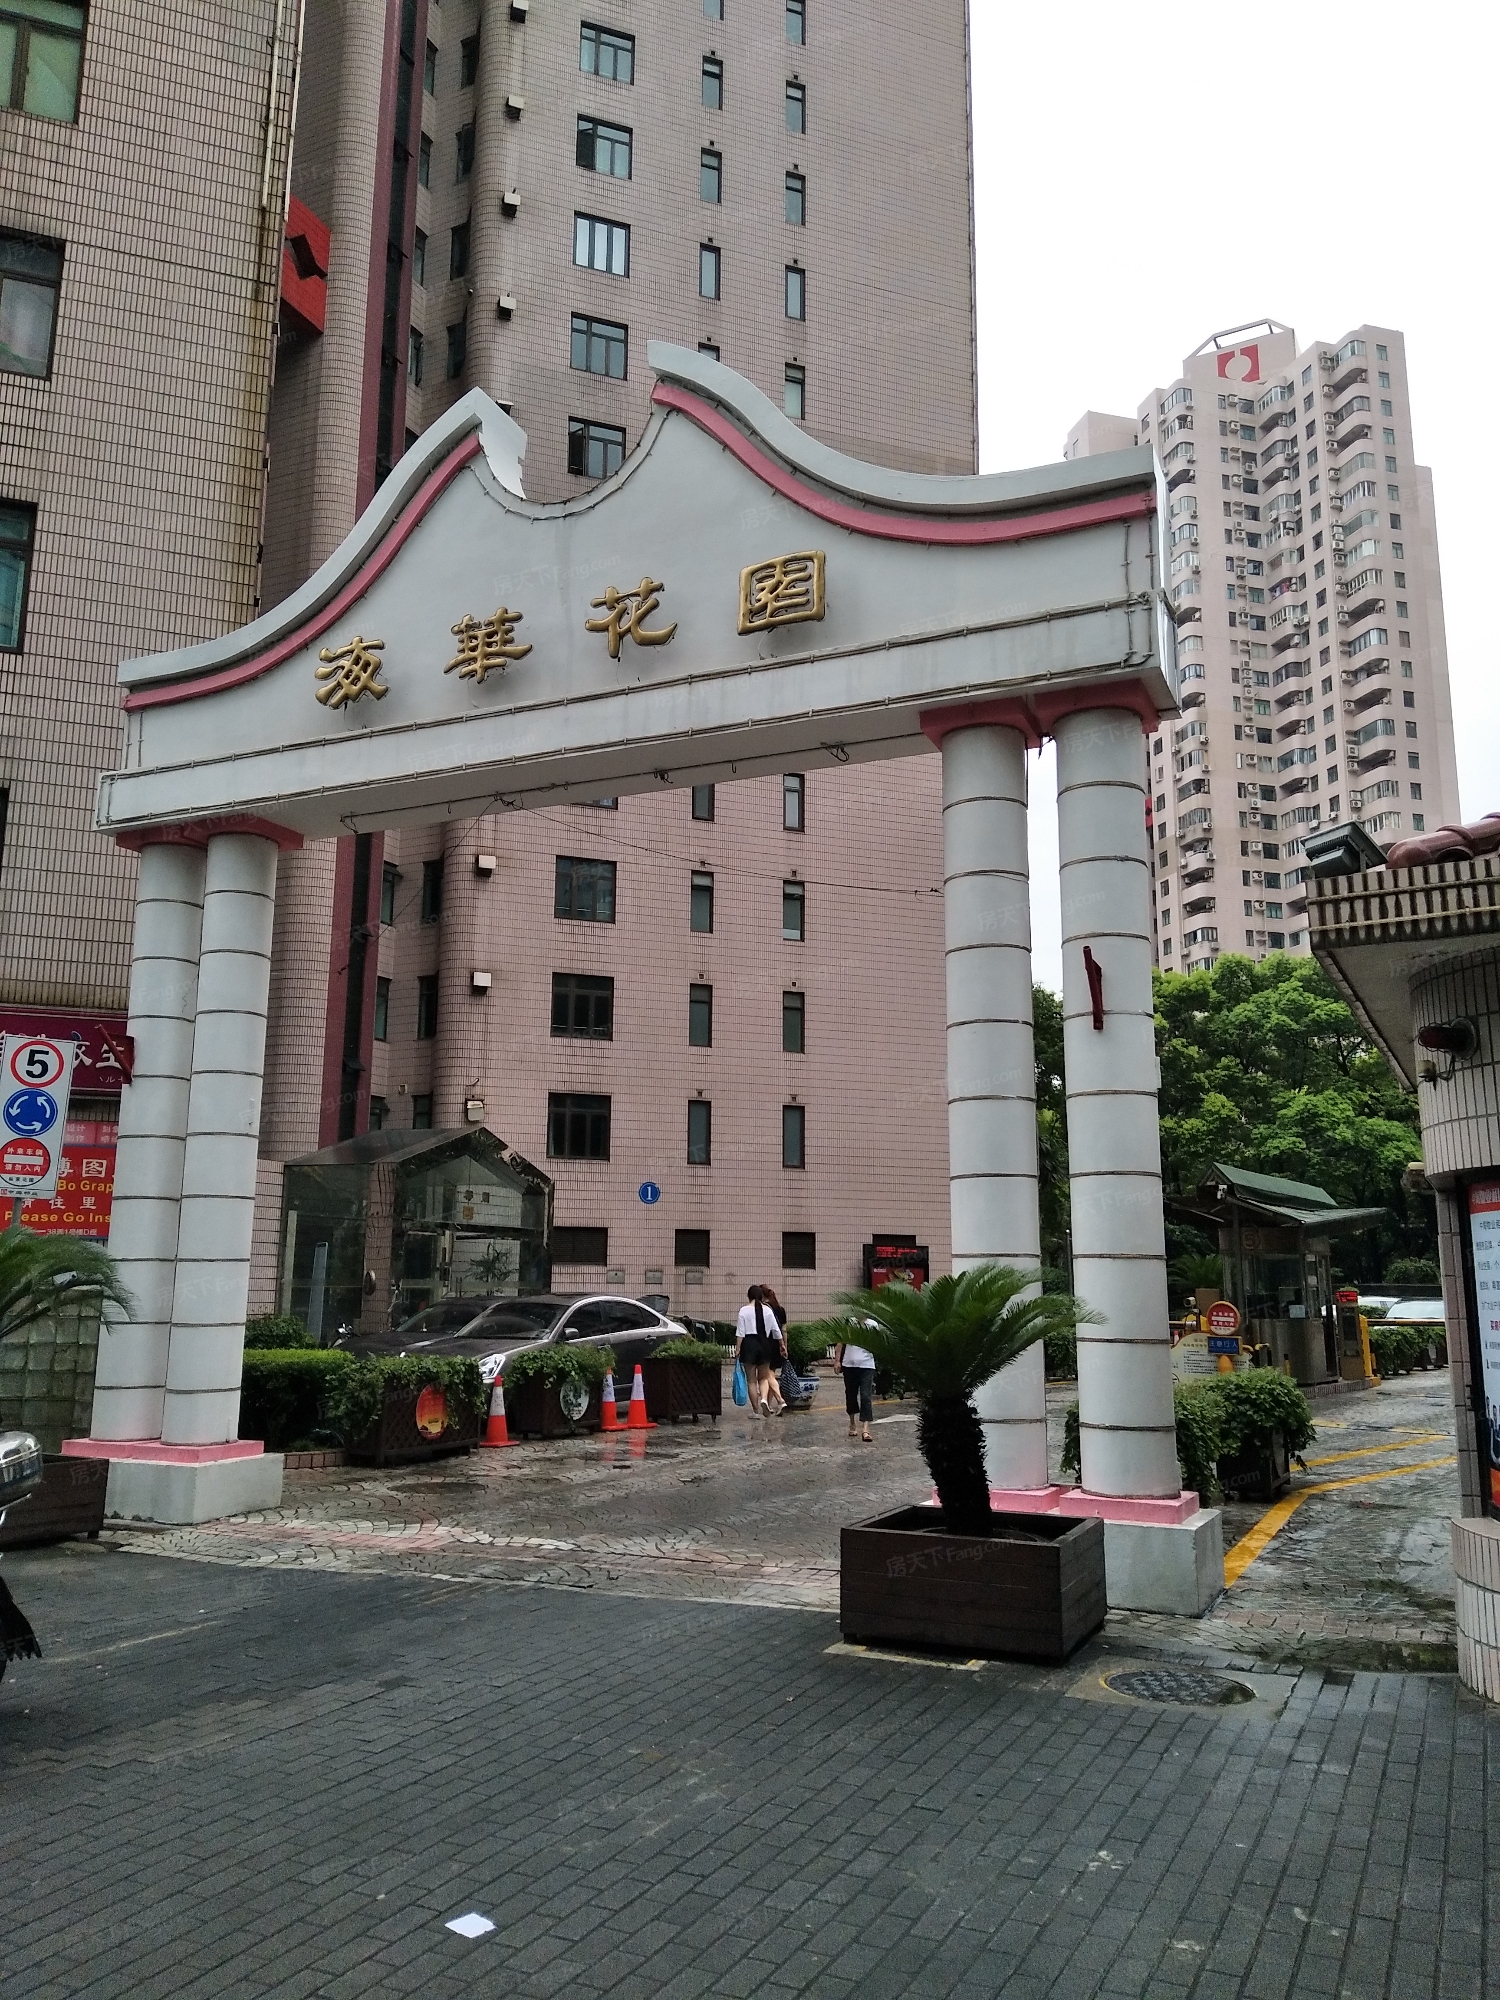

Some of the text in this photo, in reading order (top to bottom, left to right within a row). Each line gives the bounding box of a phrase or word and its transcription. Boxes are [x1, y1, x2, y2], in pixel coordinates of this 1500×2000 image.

[26, 1048, 50, 1079] 5
[58, 1180, 76, 1191] Bo
[646, 1186, 653, 1200] 1
[4, 1210, 58, 1222] Pease
[63, 1211, 84, 1222] Go
